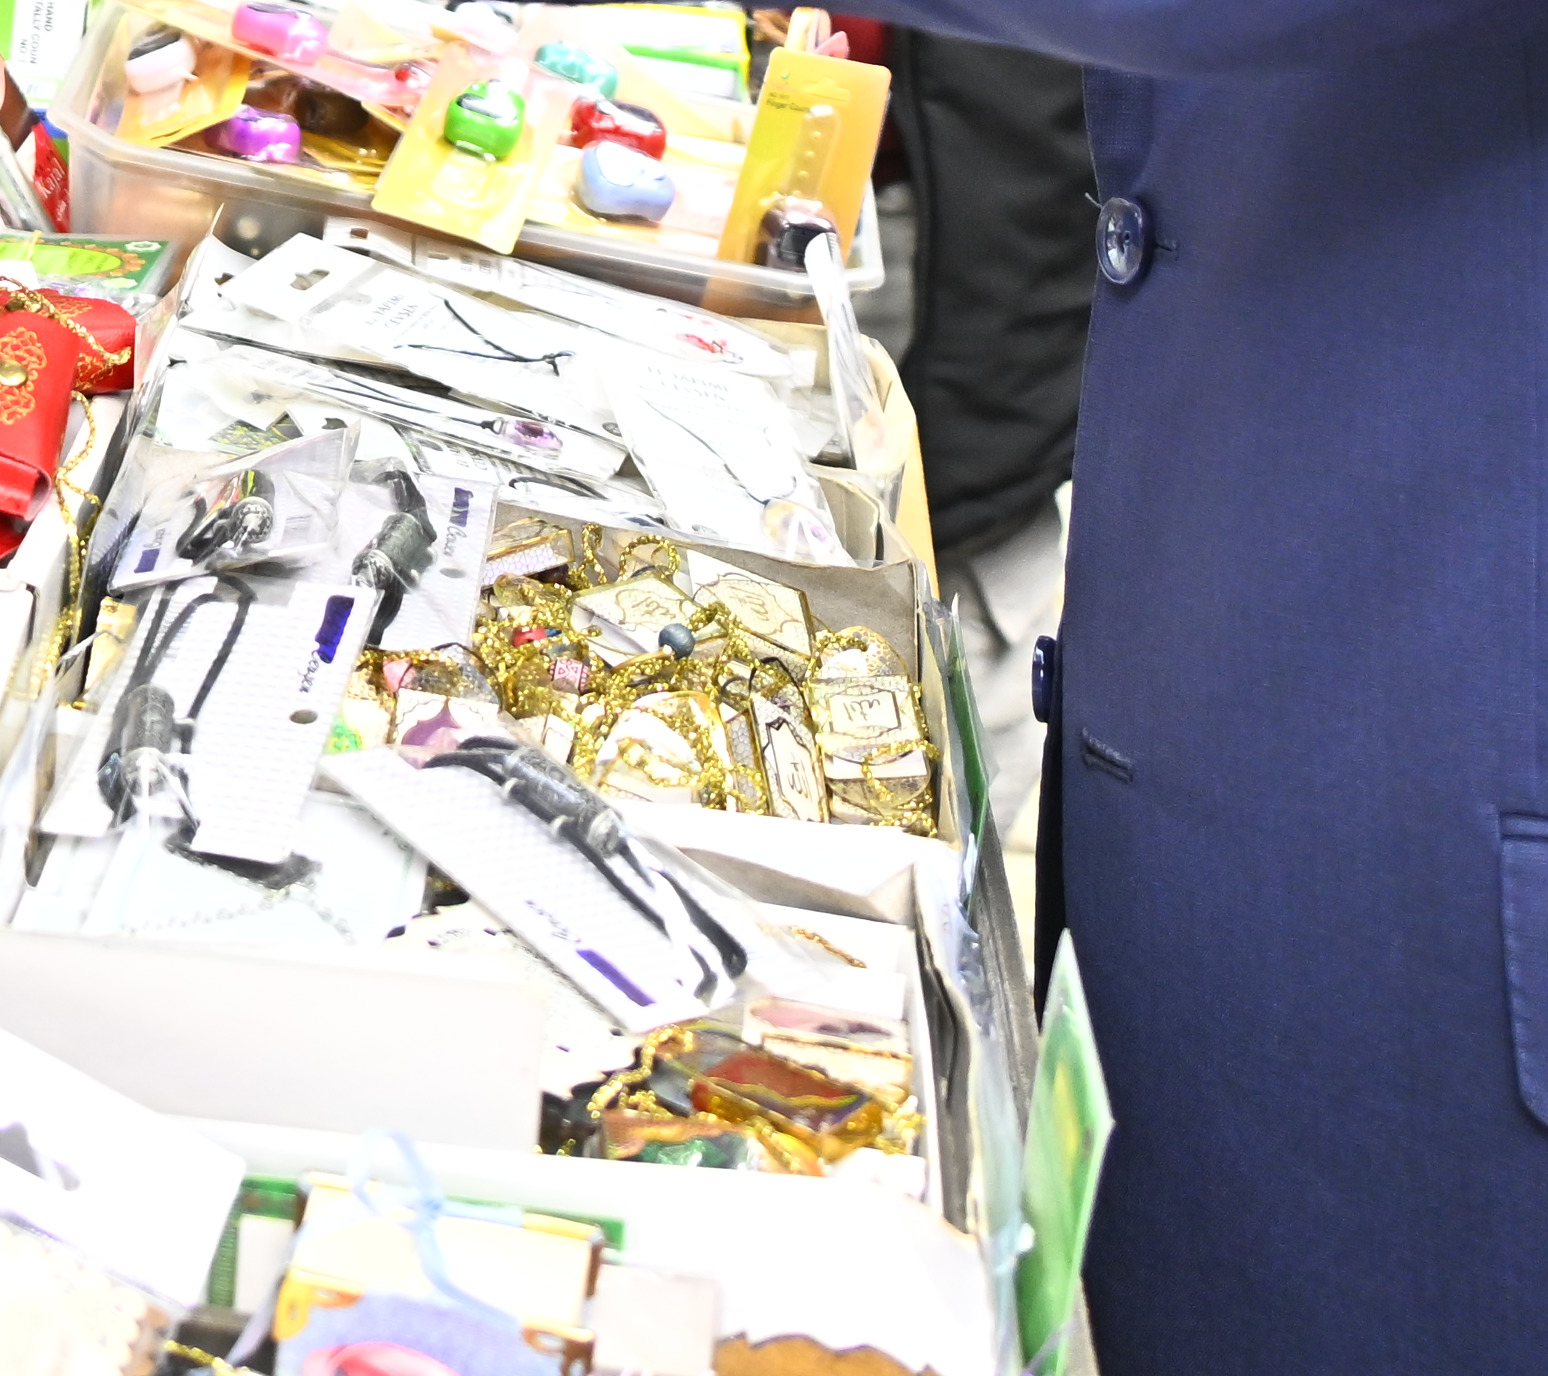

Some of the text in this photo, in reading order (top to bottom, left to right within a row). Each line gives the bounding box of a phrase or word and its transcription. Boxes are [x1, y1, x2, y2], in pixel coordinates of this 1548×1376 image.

[33, 0, 44, 31] TALLY
[44, 1, 55, 32] HAND
[34, 156, 66, 200] Kajal
